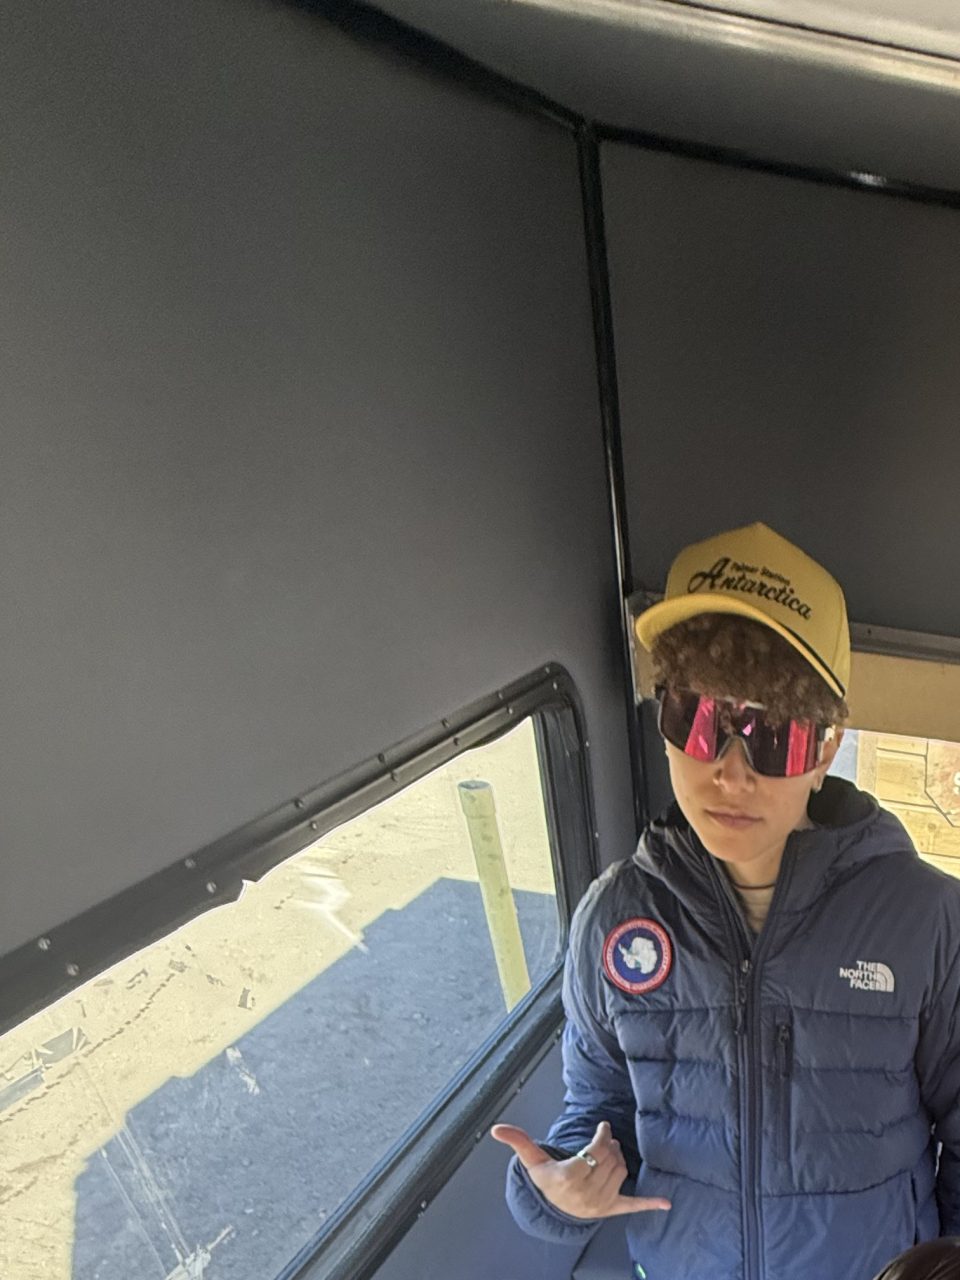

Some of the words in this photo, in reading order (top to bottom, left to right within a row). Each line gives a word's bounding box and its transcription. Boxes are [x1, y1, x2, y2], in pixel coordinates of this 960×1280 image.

[687, 557, 811, 620] Antarctica
[856, 960, 877, 972] THE
[839, 967, 877, 980] NORTH
[849, 978, 877, 991] FACE
